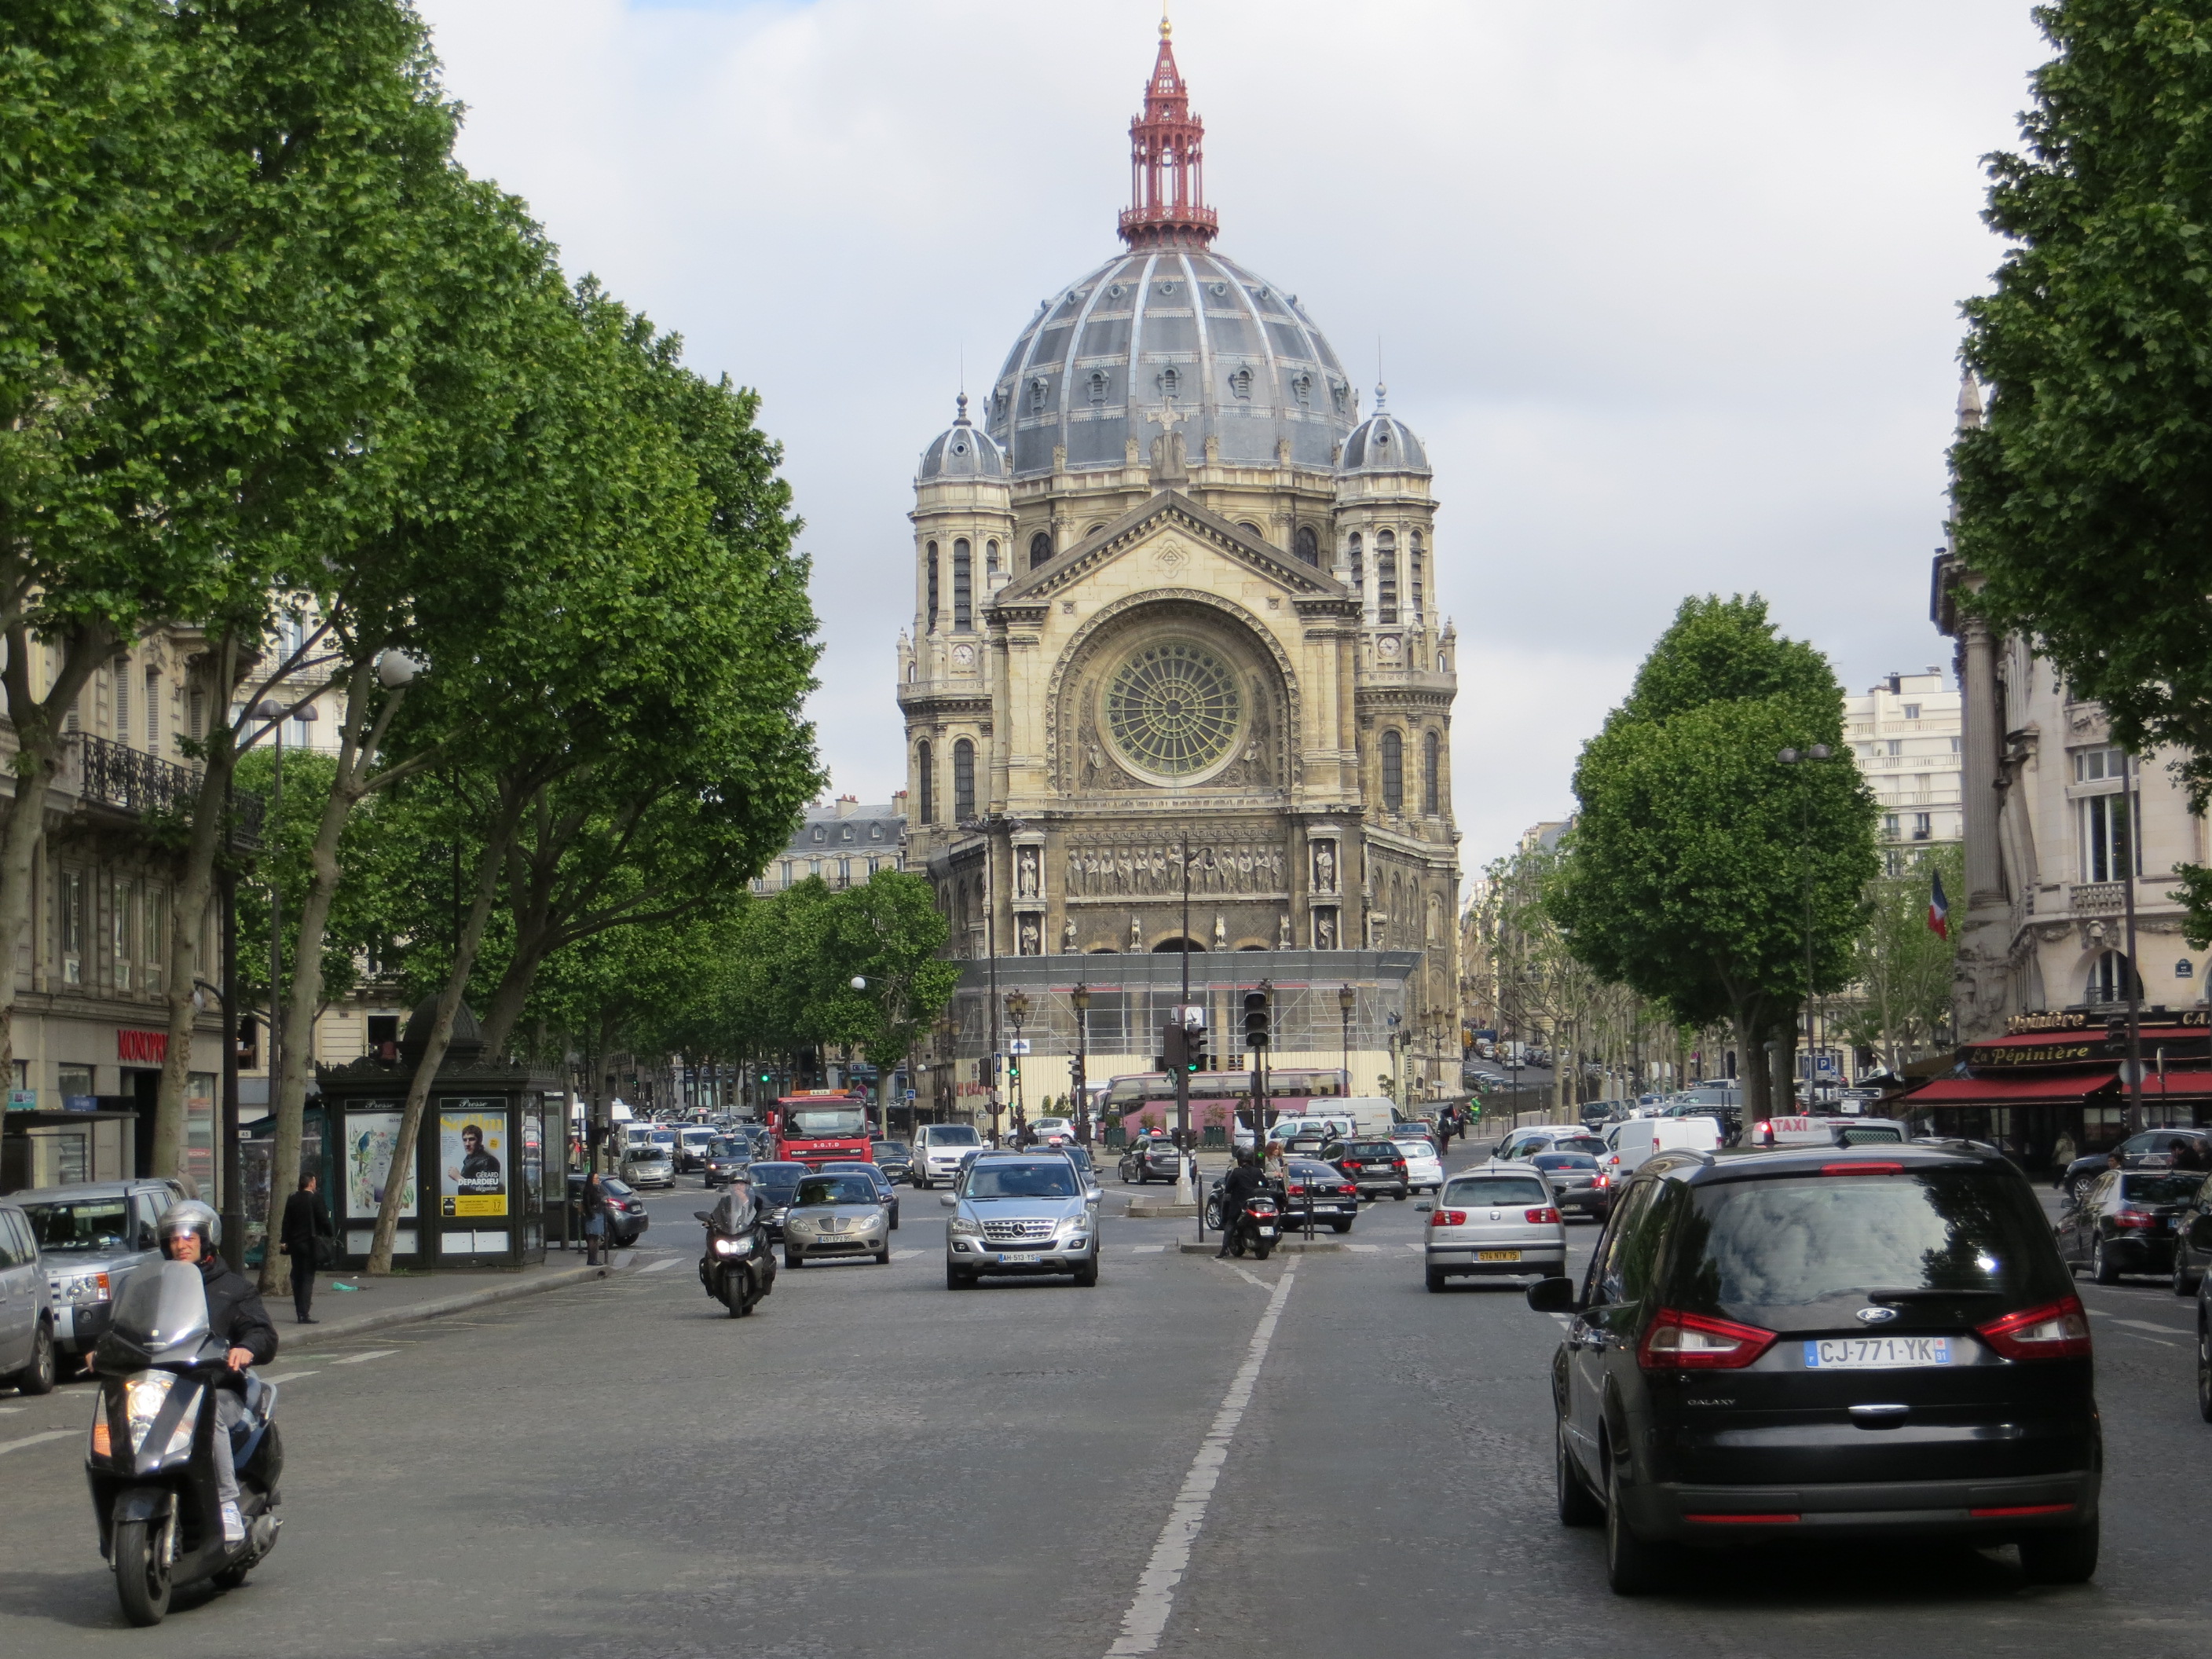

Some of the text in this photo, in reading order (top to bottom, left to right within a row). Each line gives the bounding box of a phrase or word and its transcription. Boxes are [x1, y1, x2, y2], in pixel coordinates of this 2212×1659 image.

[1992, 1046, 2089, 1064] Pépinière
[459, 1099, 488, 1108] Presse
[1773, 1119, 1808, 1132] TAXI
[458, 1177, 499, 1186] DEPARDIEU
[1865, 1309, 1887, 1319] Ford
[1820, 1339, 1932, 1362] CJ-771-YK
[1936, 1352, 1946, 1361] 91
